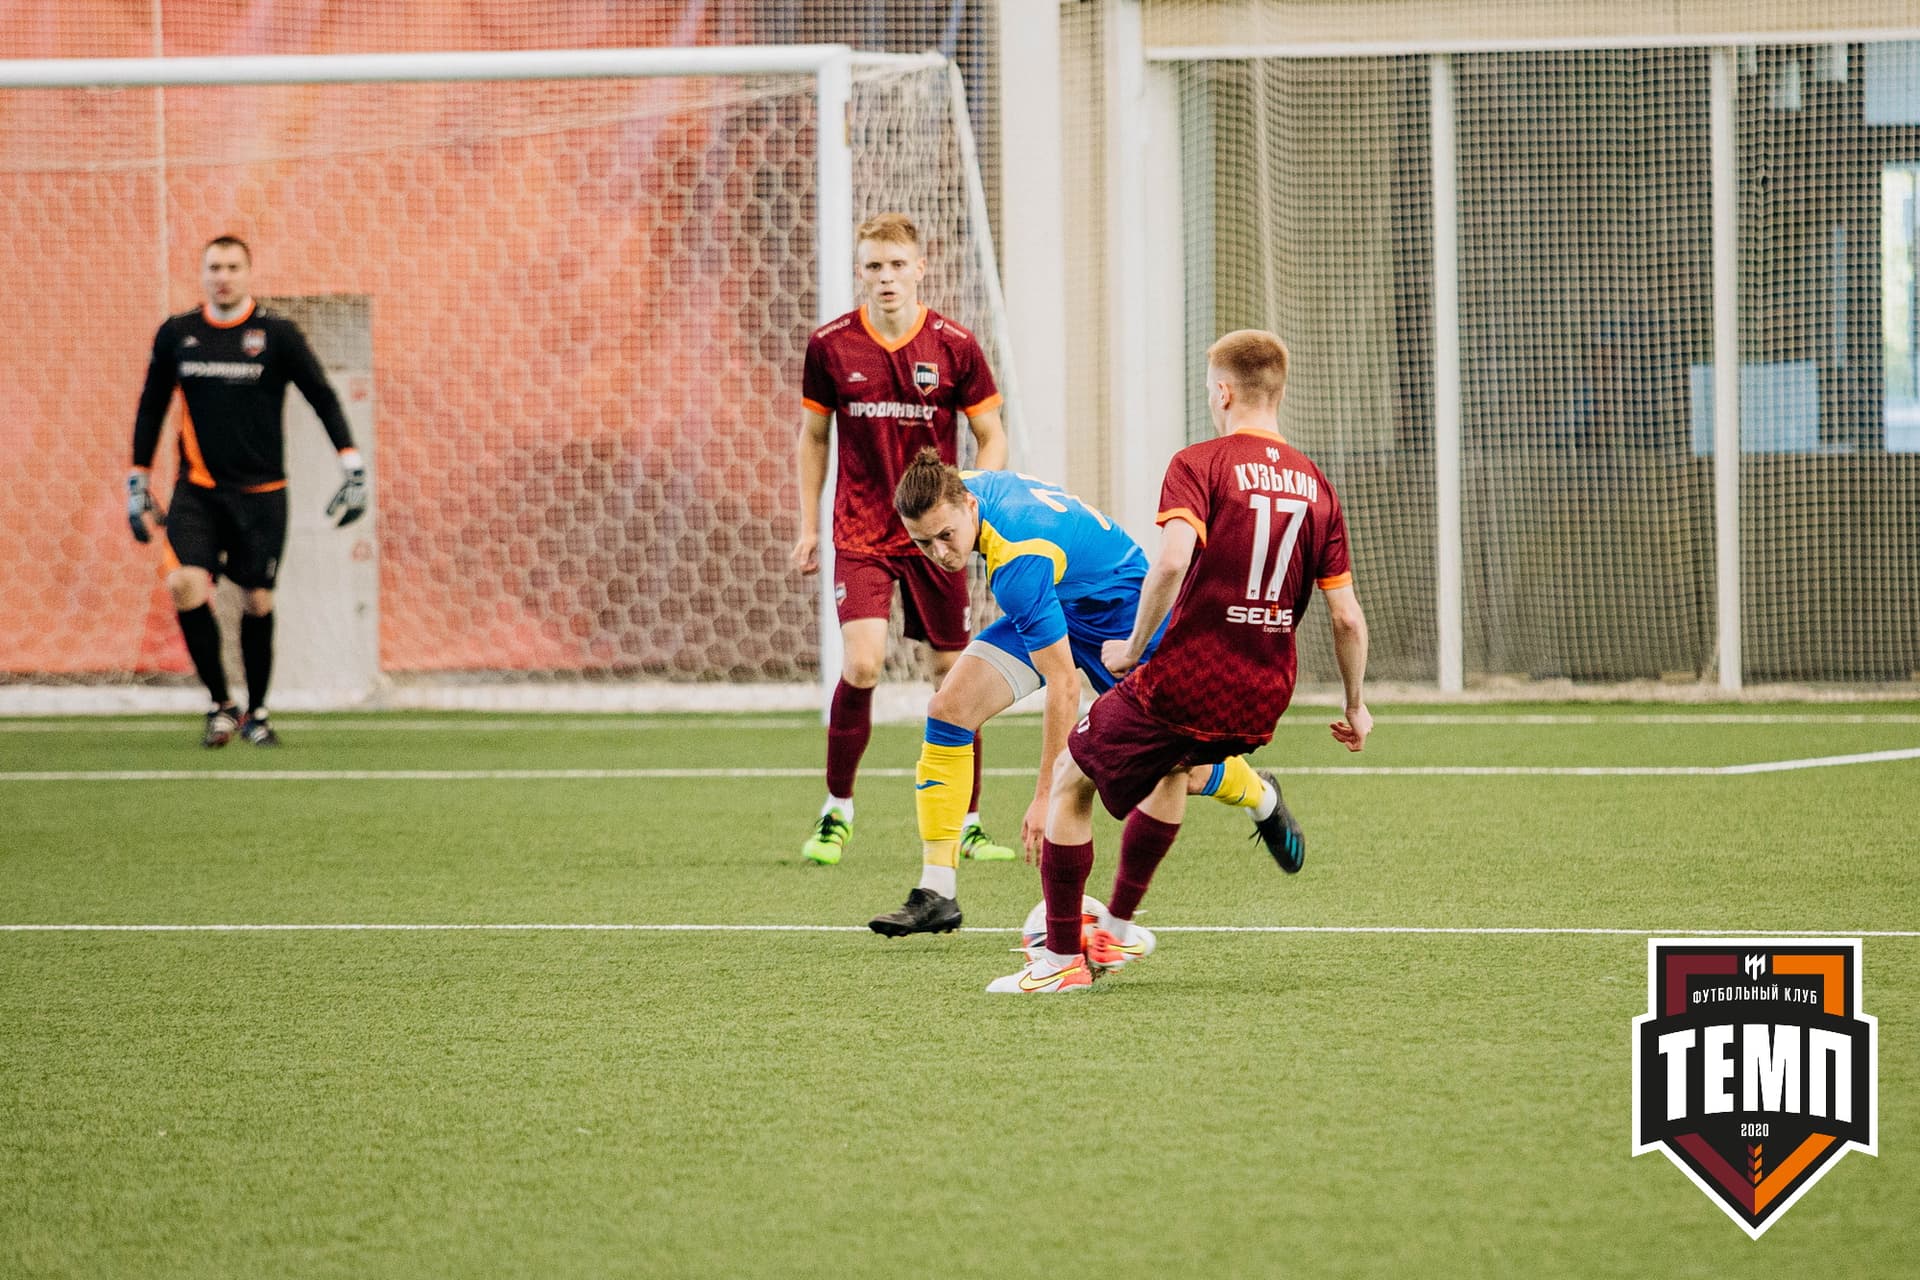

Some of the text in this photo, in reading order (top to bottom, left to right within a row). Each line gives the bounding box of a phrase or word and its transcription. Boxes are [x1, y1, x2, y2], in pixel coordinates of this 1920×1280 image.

[849, 401, 938, 420] ПРОДИНВЕСТ
[1234, 463, 1318, 503] КУЗЬКИН
[1246, 494, 1309, 602] 17
